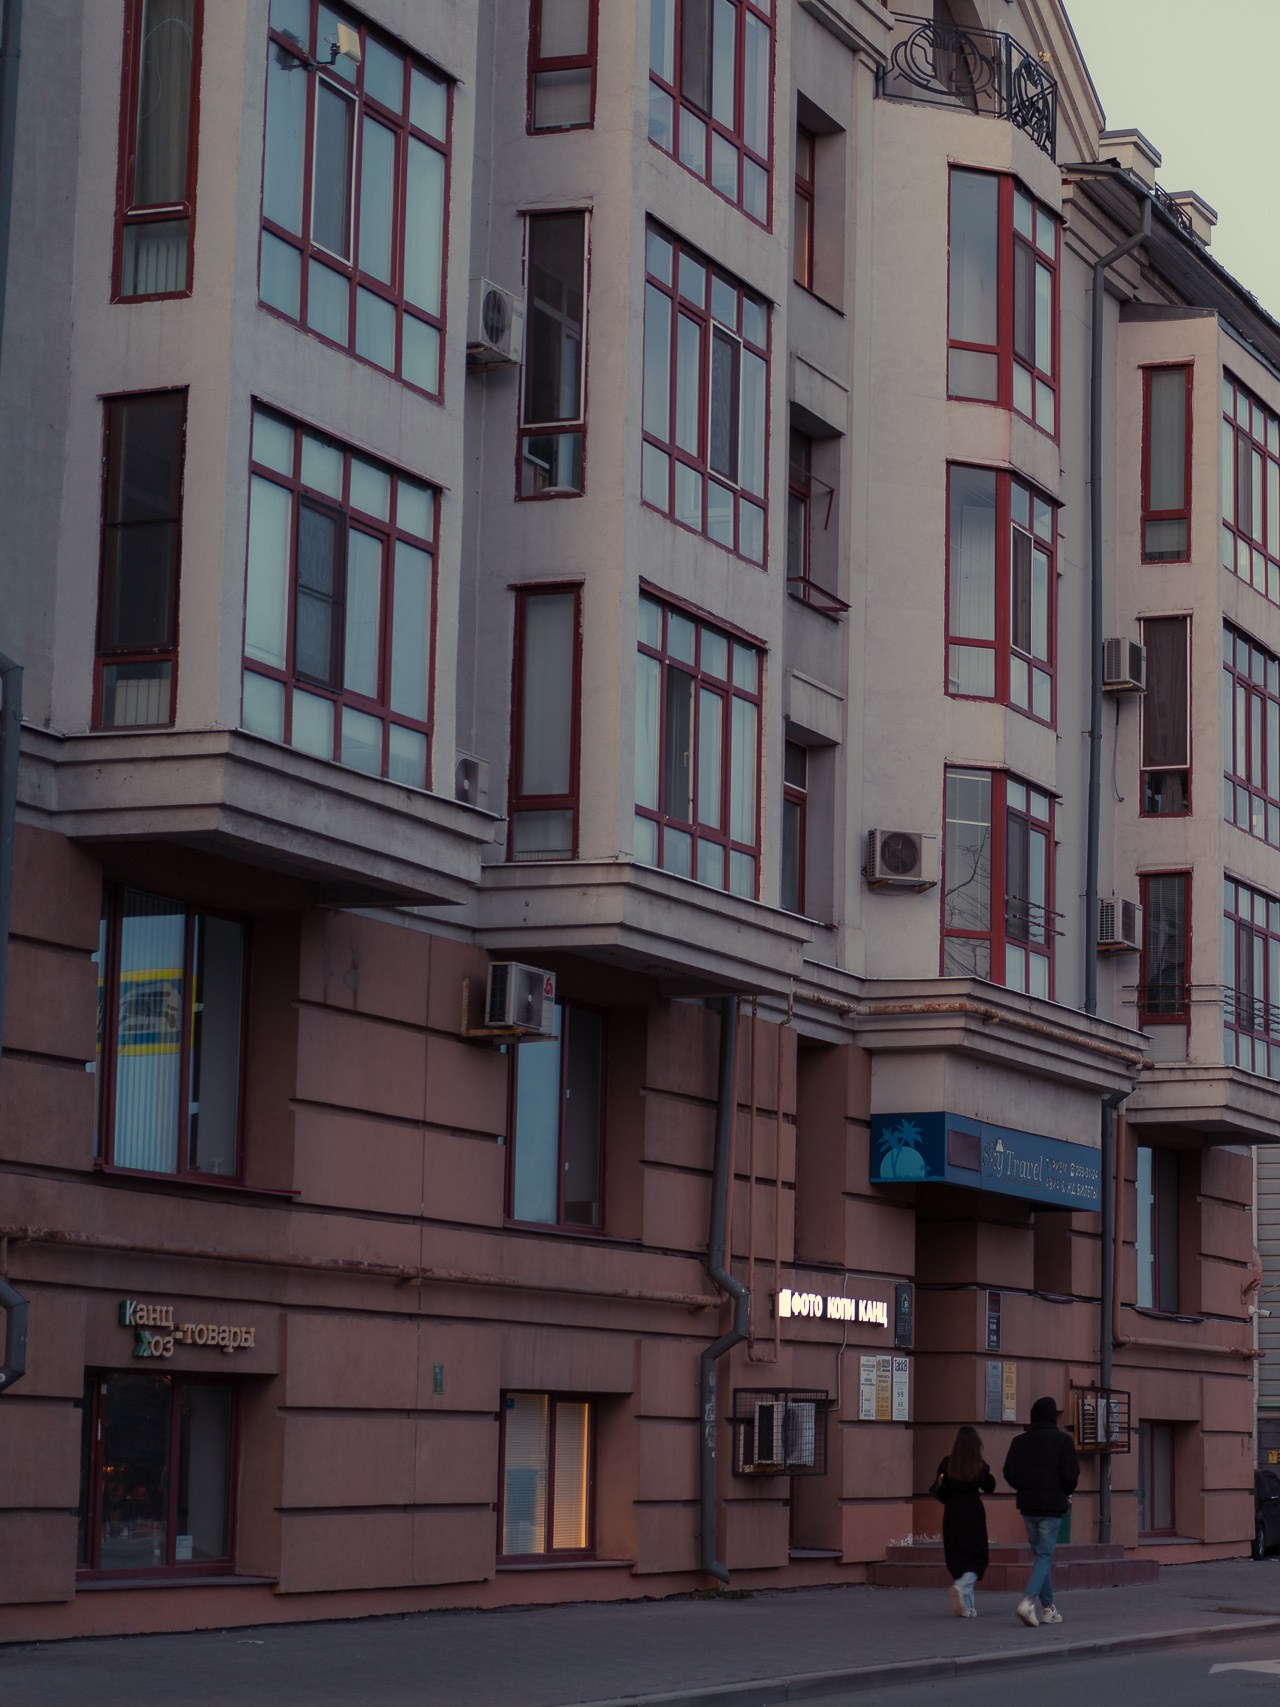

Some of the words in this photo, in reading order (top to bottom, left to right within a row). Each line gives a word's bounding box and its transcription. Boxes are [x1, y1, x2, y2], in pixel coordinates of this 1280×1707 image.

[1006, 1150, 1042, 1182] Travel
[121, 1299, 174, 1331] Канц
[791, 1291, 823, 1318] ФОТО
[827, 1295, 856, 1321] КОПИ
[859, 1299, 888, 1328] КАНЦ
[134, 1330, 175, 1357] Хоз
